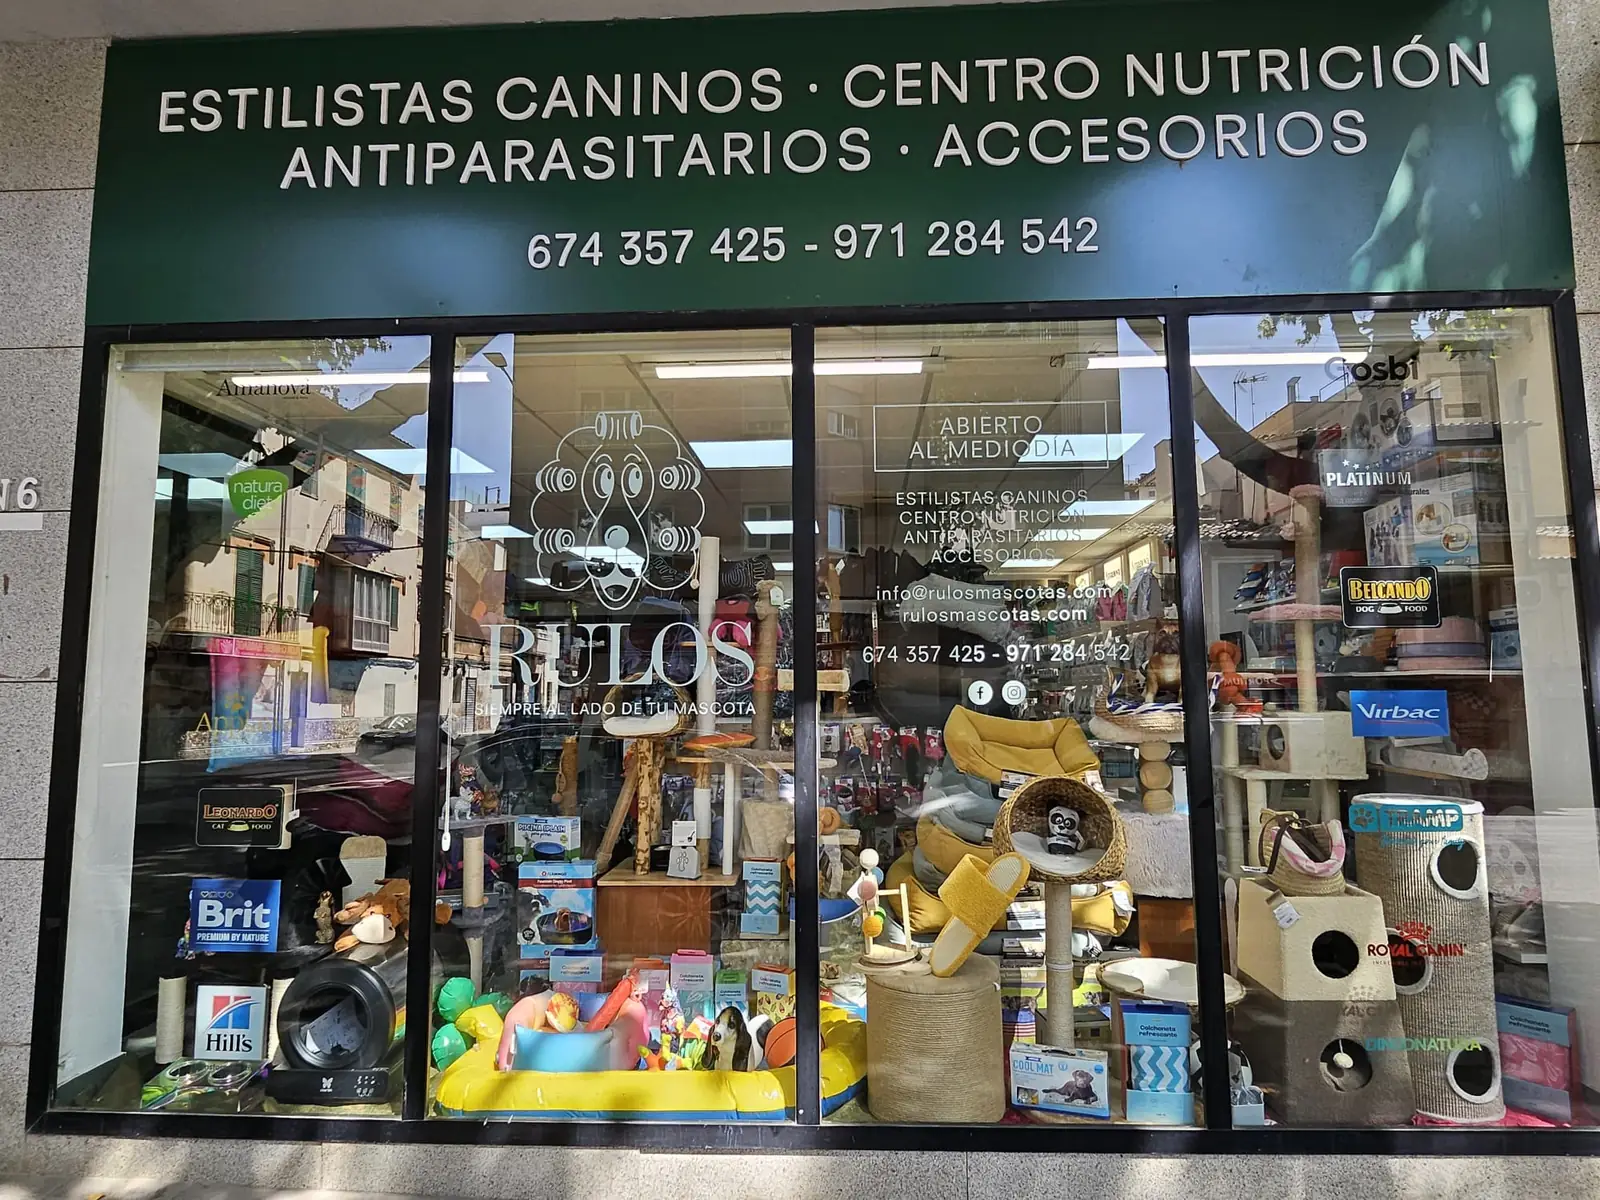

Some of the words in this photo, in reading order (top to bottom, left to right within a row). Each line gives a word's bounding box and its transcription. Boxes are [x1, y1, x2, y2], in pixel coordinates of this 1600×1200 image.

[158, 79, 474, 133] ESTILISTAS
[496, 67, 783, 121] CANINOS
[843, 55, 1101, 108] CENTRO
[1126, 34, 1491, 97] NUTRICIÓN
[280, 126, 872, 189] ANTIPARASITARIOS
[933, 109, 1368, 168] ACCESORIOS
[527, 232, 604, 271] 674
[618, 229, 694, 267] 357
[709, 226, 786, 263] 425
[833, 222, 905, 260] 971
[927, 219, 1005, 258] 284
[1021, 216, 1099, 254] 542
[940, 416, 1042, 435] ABIERTO
[909, 441, 938, 459] AL
[948, 436, 1076, 459] MEDIODÍA
[233, 480, 283, 493] natura
[1326, 472, 1411, 487] PLATINUM
[17, 477, 38, 509] 6
[896, 491, 994, 506] ESTILISTAS
[1001, 489, 1088, 504] CANINOS
[243, 495, 273, 510] diet
[899, 510, 975, 525] CENTRO
[903, 529, 1082, 544] ANTIPARASITARIOS
[931, 549, 1055, 563] ACCESORIOS
[876, 585, 1112, 602] info@rulosmascotas.com
[1348, 577, 1431, 601] BELCANDO
[903, 607, 1087, 622] rulosmascotas.com
[480, 621, 755, 688] RULOS
[862, 646, 899, 663] 674
[906, 646, 941, 662] 357
[949, 645, 986, 662] 425
[1006, 645, 1041, 662] 971
[1050, 644, 1087, 661] 284
[1094, 644, 1131, 661] 542
[475, 702, 541, 716] SIEMPRE
[545, 702, 565, 715] AL
[571, 702, 616, 715] LADO
[621, 701, 643, 715] DE
[647, 701, 667, 715] TU
[673, 700, 757, 715] MASCOTA
[1356, 703, 1440, 719] Virbac
[203, 804, 277, 820] LEONARDO
[198, 900, 270, 929] Brit
[196, 932, 230, 942] PREMIUM
[231, 932, 241, 942] BY
[242, 933, 269, 943] NATURE
[1367, 944, 1413, 957] ROYAL
[1416, 943, 1465, 957] CANIN
[1139, 1024, 1177, 1032] Colchoneta
[205, 1033, 253, 1053] Hill's
[1013, 1060, 1035, 1072] COOL
[1036, 1063, 1055, 1075] MAT
